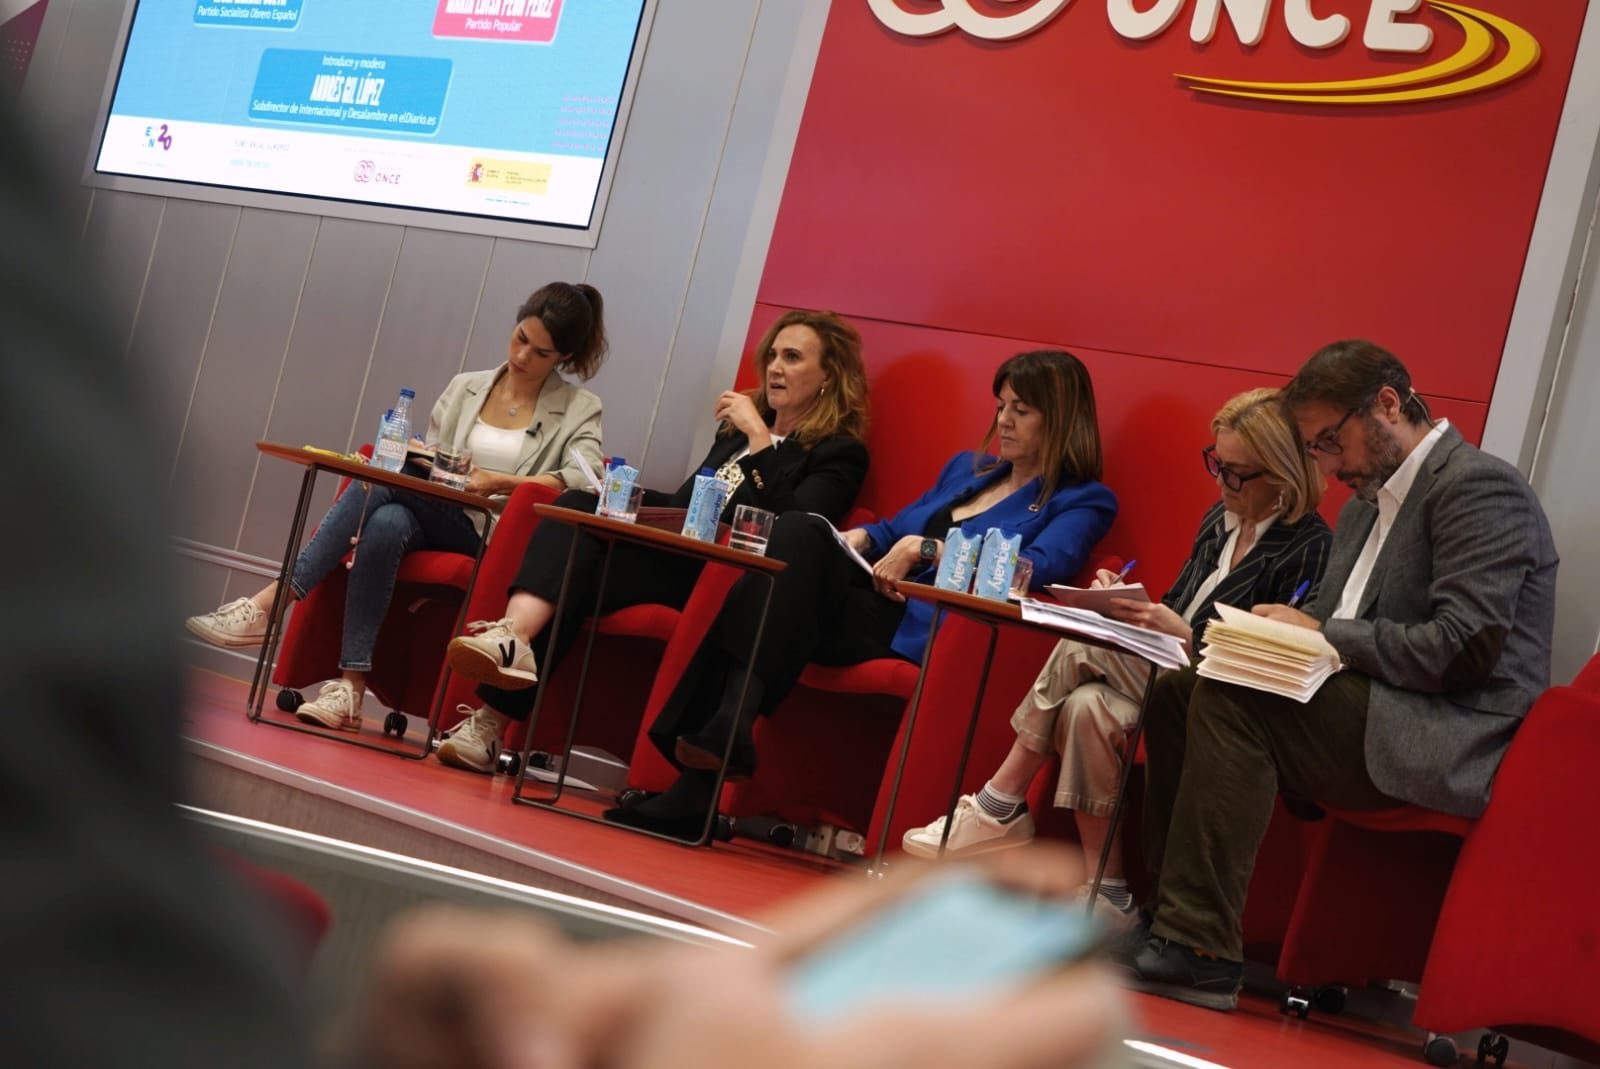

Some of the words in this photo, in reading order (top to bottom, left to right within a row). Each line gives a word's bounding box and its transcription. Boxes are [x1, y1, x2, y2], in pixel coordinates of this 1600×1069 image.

[465, 18, 492, 31] Partido
[492, 19, 523, 33] Popular
[322, 55, 353, 68] Introduce
[360, 57, 386, 70] modera
[310, 70, 345, 102] ANDRÉS
[342, 76, 359, 105] GIL
[356, 72, 385, 106] LÓPEZ
[253, 99, 290, 113] Subdirector
[289, 104, 299, 113] de
[299, 104, 342, 118] Internacional
[348, 107, 388, 122] Desalambre
[388, 113, 399, 123] en
[399, 111, 437, 126] elDiario.es
[375, 172, 401, 185] ONCE
